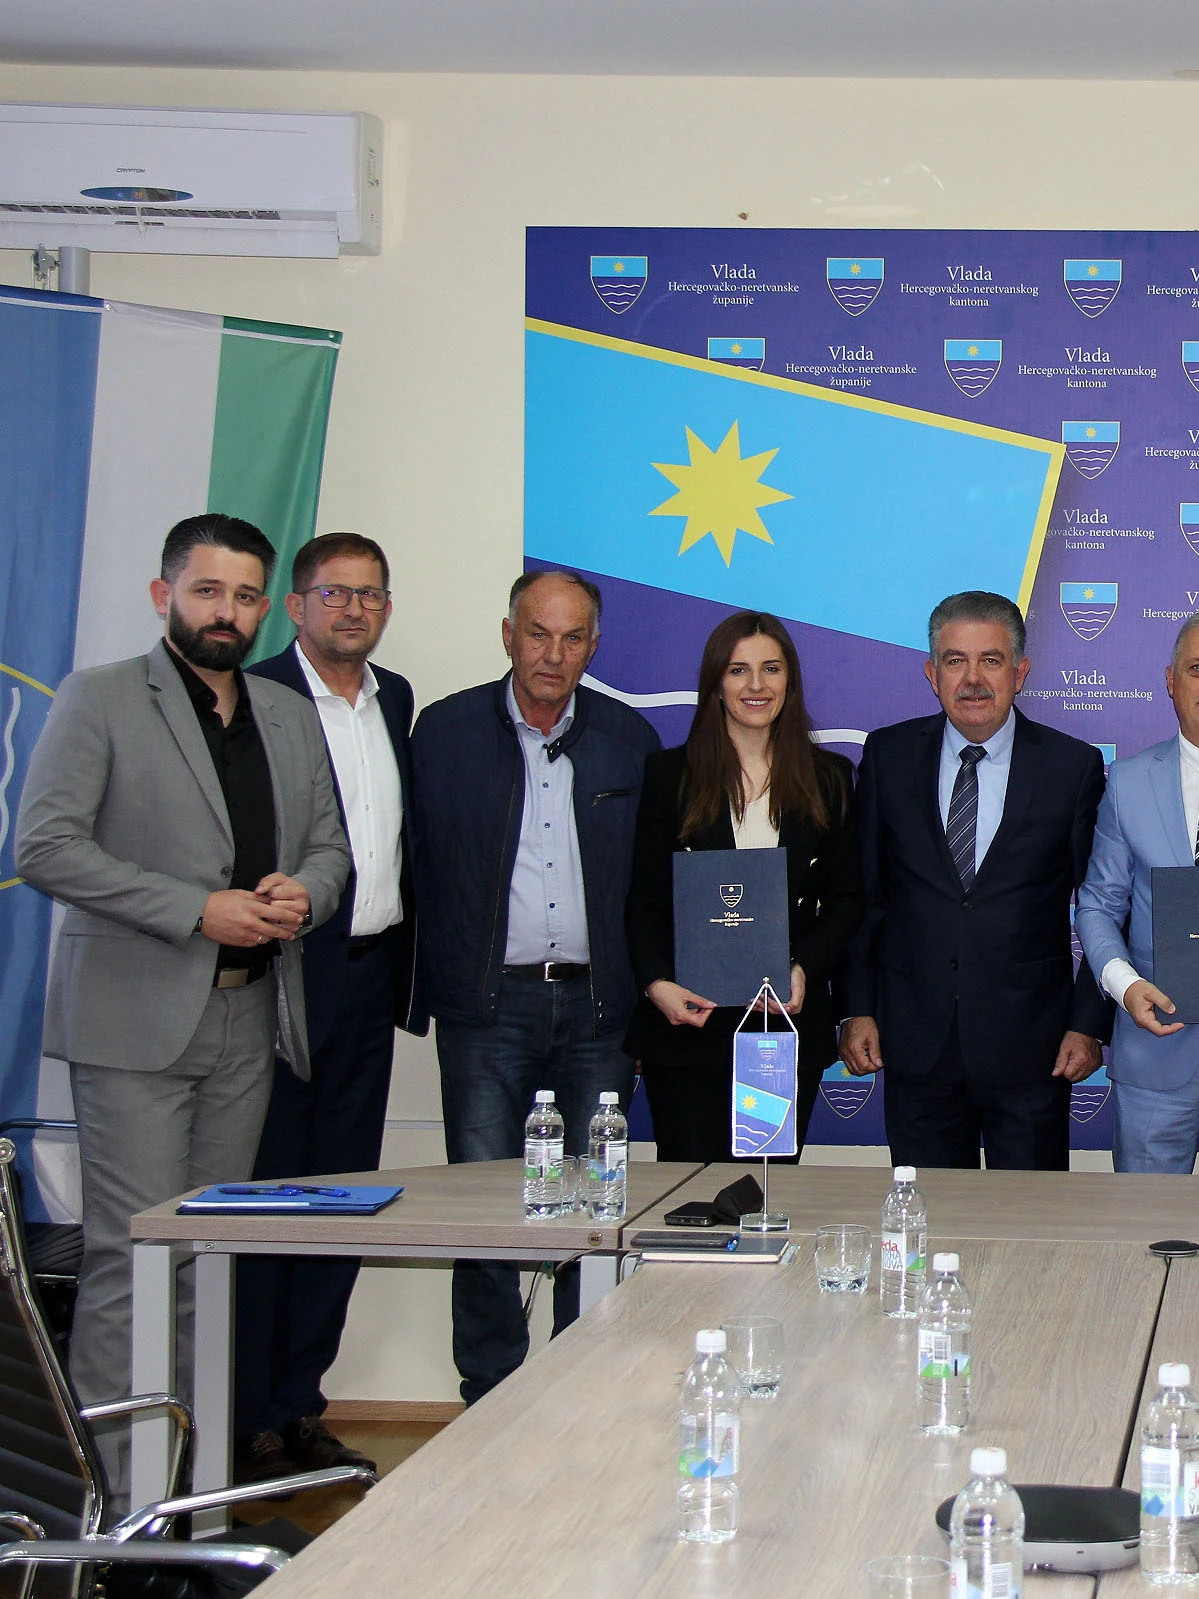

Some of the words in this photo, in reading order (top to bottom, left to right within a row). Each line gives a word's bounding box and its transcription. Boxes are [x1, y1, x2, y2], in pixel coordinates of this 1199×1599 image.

[710, 263, 757, 280] Vlada
[946, 265, 993, 281] Vlada
[668, 281, 800, 295] Hercegovačko-neretvanske
[900, 283, 1039, 297] Hercegovačko-neretvanskog
[712, 294, 755, 308] županije
[949, 295, 990, 307] kantona
[827, 344, 875, 361] Vlada
[1063, 346, 1111, 363] Vlada
[785, 362, 917, 377] Hercegovačko-neretvanske
[1017, 364, 1157, 379] Hercegovačko-neretvanskog
[829, 375, 872, 389] županije
[1066, 377, 1107, 389] kantona
[1063, 508, 1109, 524] Vlada
[1045, 526, 1156, 540] govačko-neretvanskog
[1065, 538, 1105, 550] kantona
[1060, 669, 1107, 686] Vlada
[1063, 699, 1103, 711] kantona
